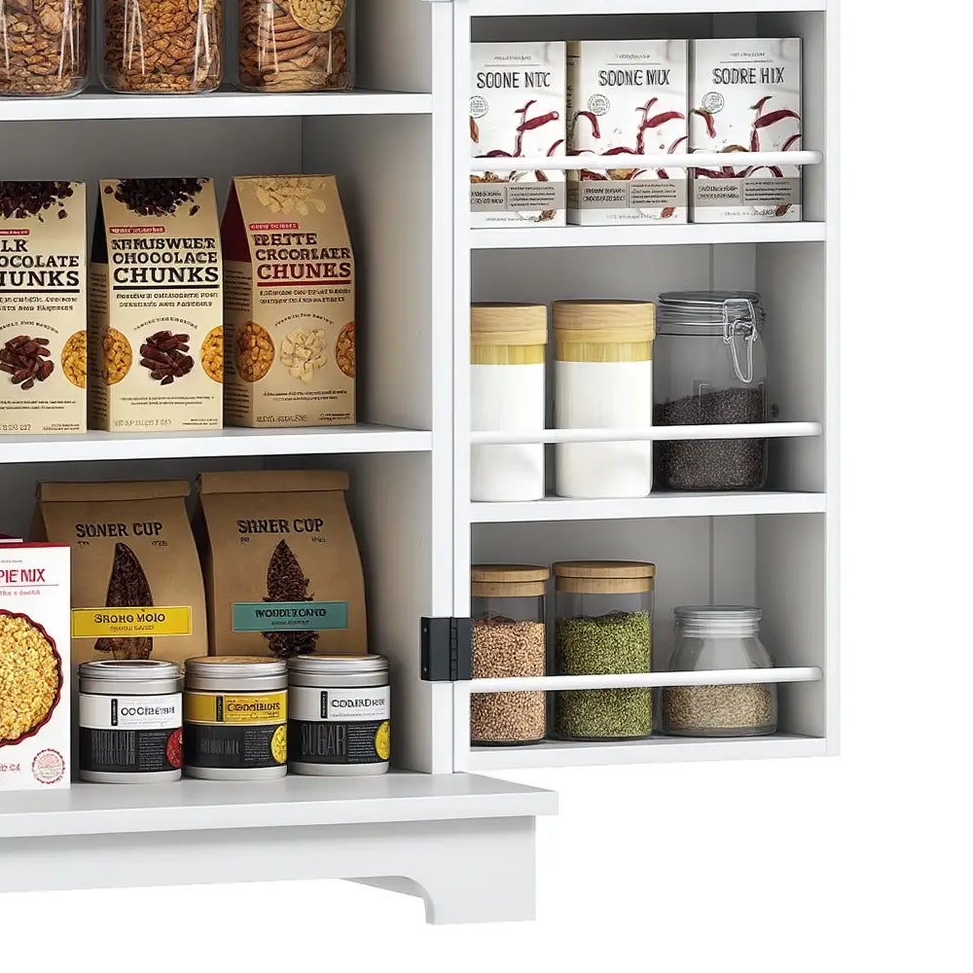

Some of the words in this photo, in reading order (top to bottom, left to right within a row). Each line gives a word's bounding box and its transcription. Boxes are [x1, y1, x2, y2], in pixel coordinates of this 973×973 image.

[113, 267, 220, 283] CHUNKS
[132, 521, 163, 536] CUP
[293, 518, 324, 533] CUP
